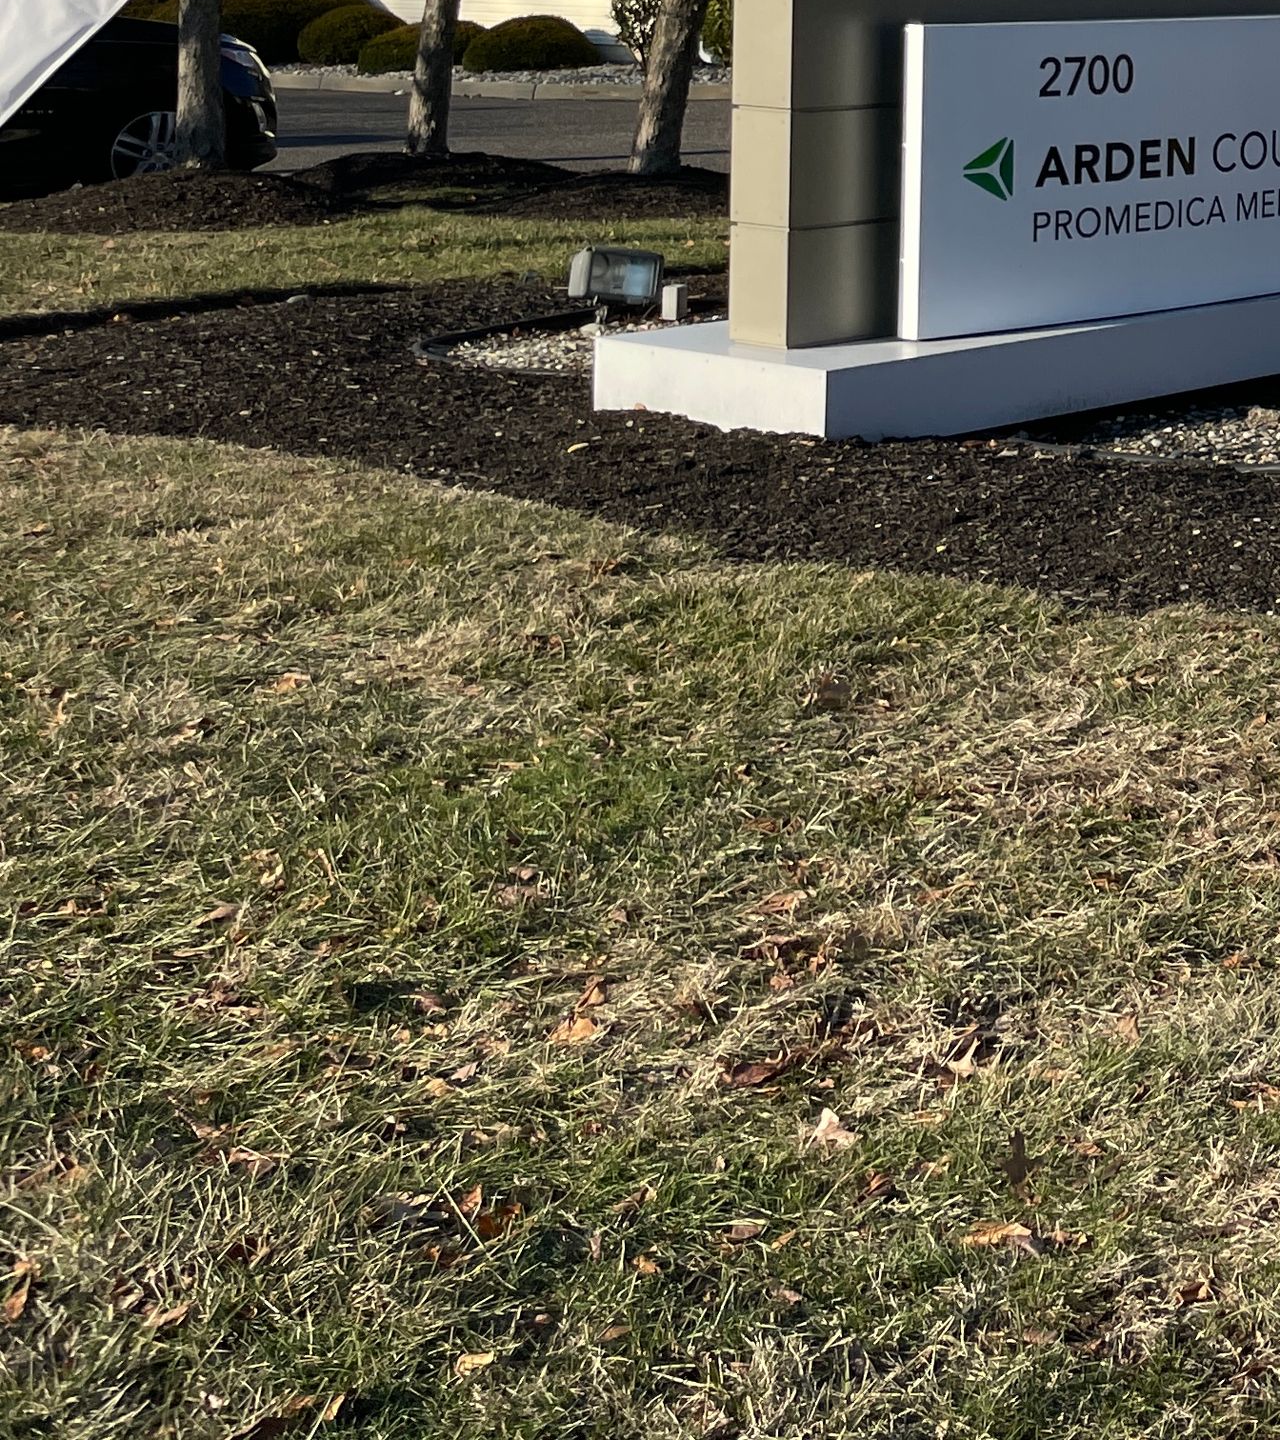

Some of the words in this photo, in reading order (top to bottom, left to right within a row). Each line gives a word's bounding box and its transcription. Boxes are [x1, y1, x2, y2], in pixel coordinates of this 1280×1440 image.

[1038, 54, 1134, 97] 2700
[1035, 136, 1196, 188] ARDEN
[1032, 195, 1226, 242] PROMEDICA
